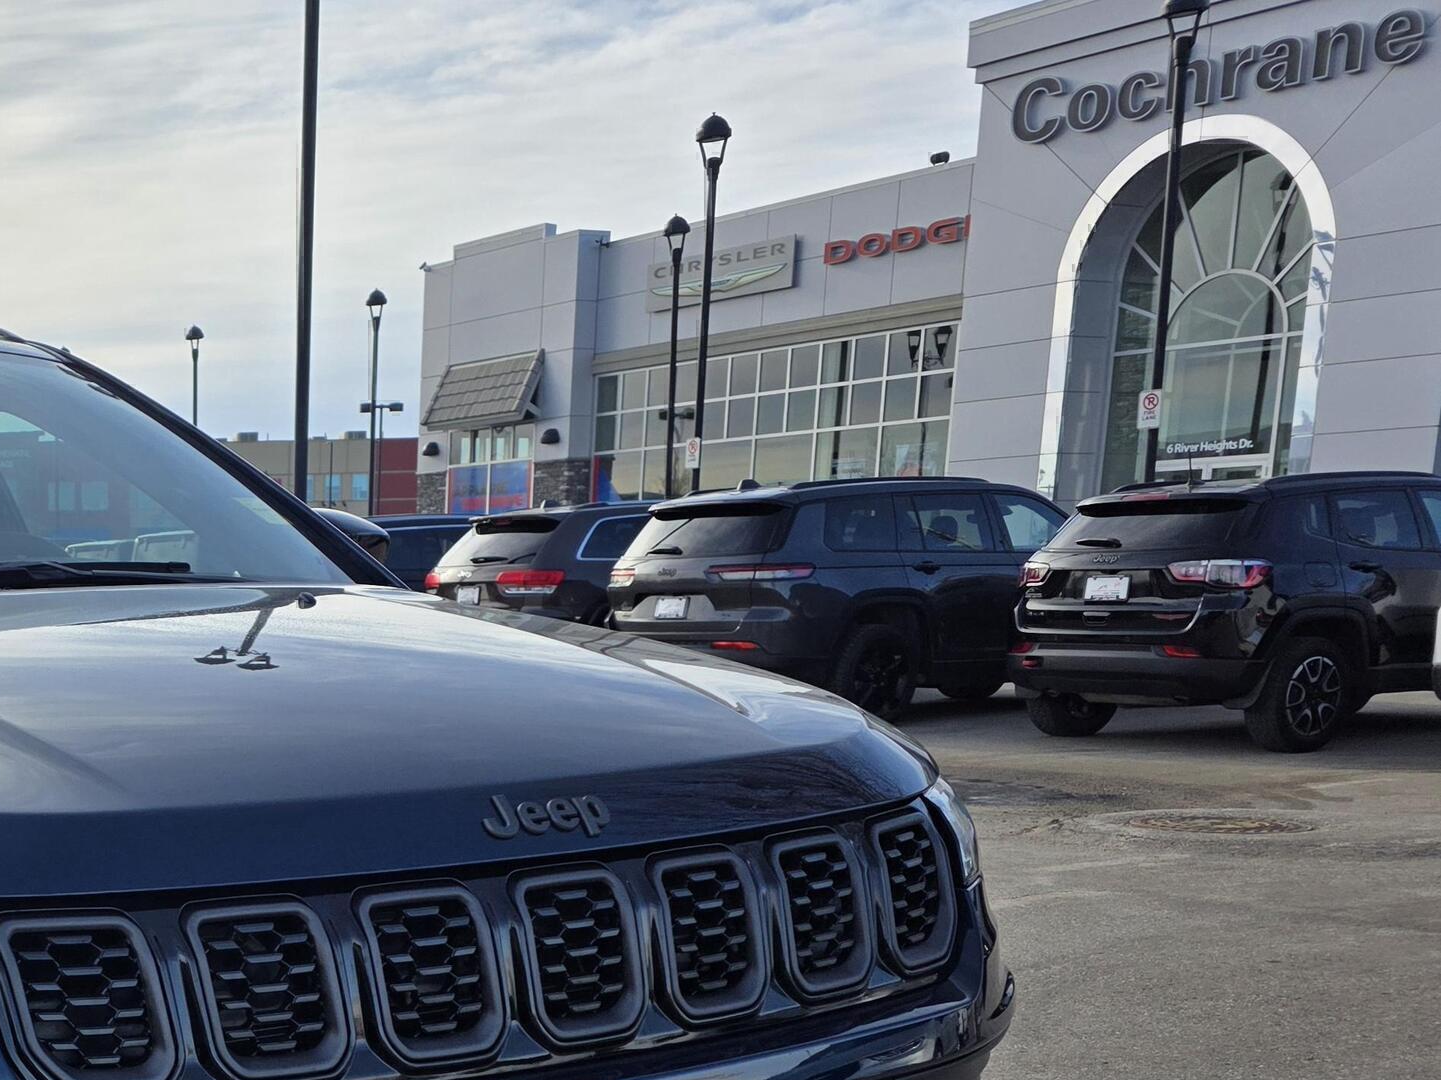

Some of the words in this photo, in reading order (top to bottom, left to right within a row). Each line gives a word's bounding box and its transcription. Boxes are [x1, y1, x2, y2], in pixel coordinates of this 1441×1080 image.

[1011, 8, 1427, 145] Cochrane
[823, 213, 972, 265] DODG
[1166, 443, 1174, 454] 6
[1174, 442, 1199, 453] River
[1200, 440, 1238, 453] Heights
[1238, 438, 1255, 449] Dr.
[1092, 553, 1120, 564] Jeep
[482, 794, 610, 840] Jeep
